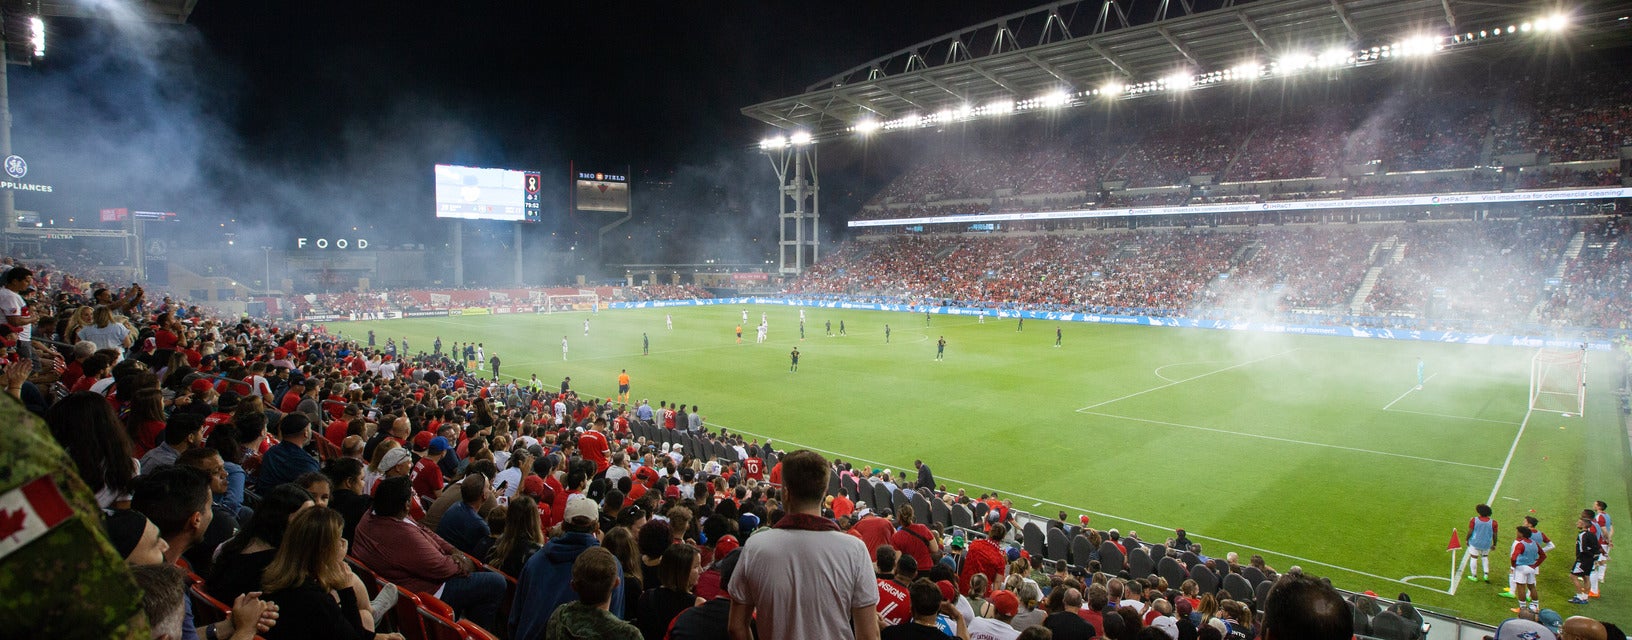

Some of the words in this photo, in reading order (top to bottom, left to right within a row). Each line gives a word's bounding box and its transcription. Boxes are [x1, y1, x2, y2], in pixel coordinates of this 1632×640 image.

[297, 237, 369, 249] FOOD
[664, 410, 673, 420] 24
[747, 463, 759, 474] 10
